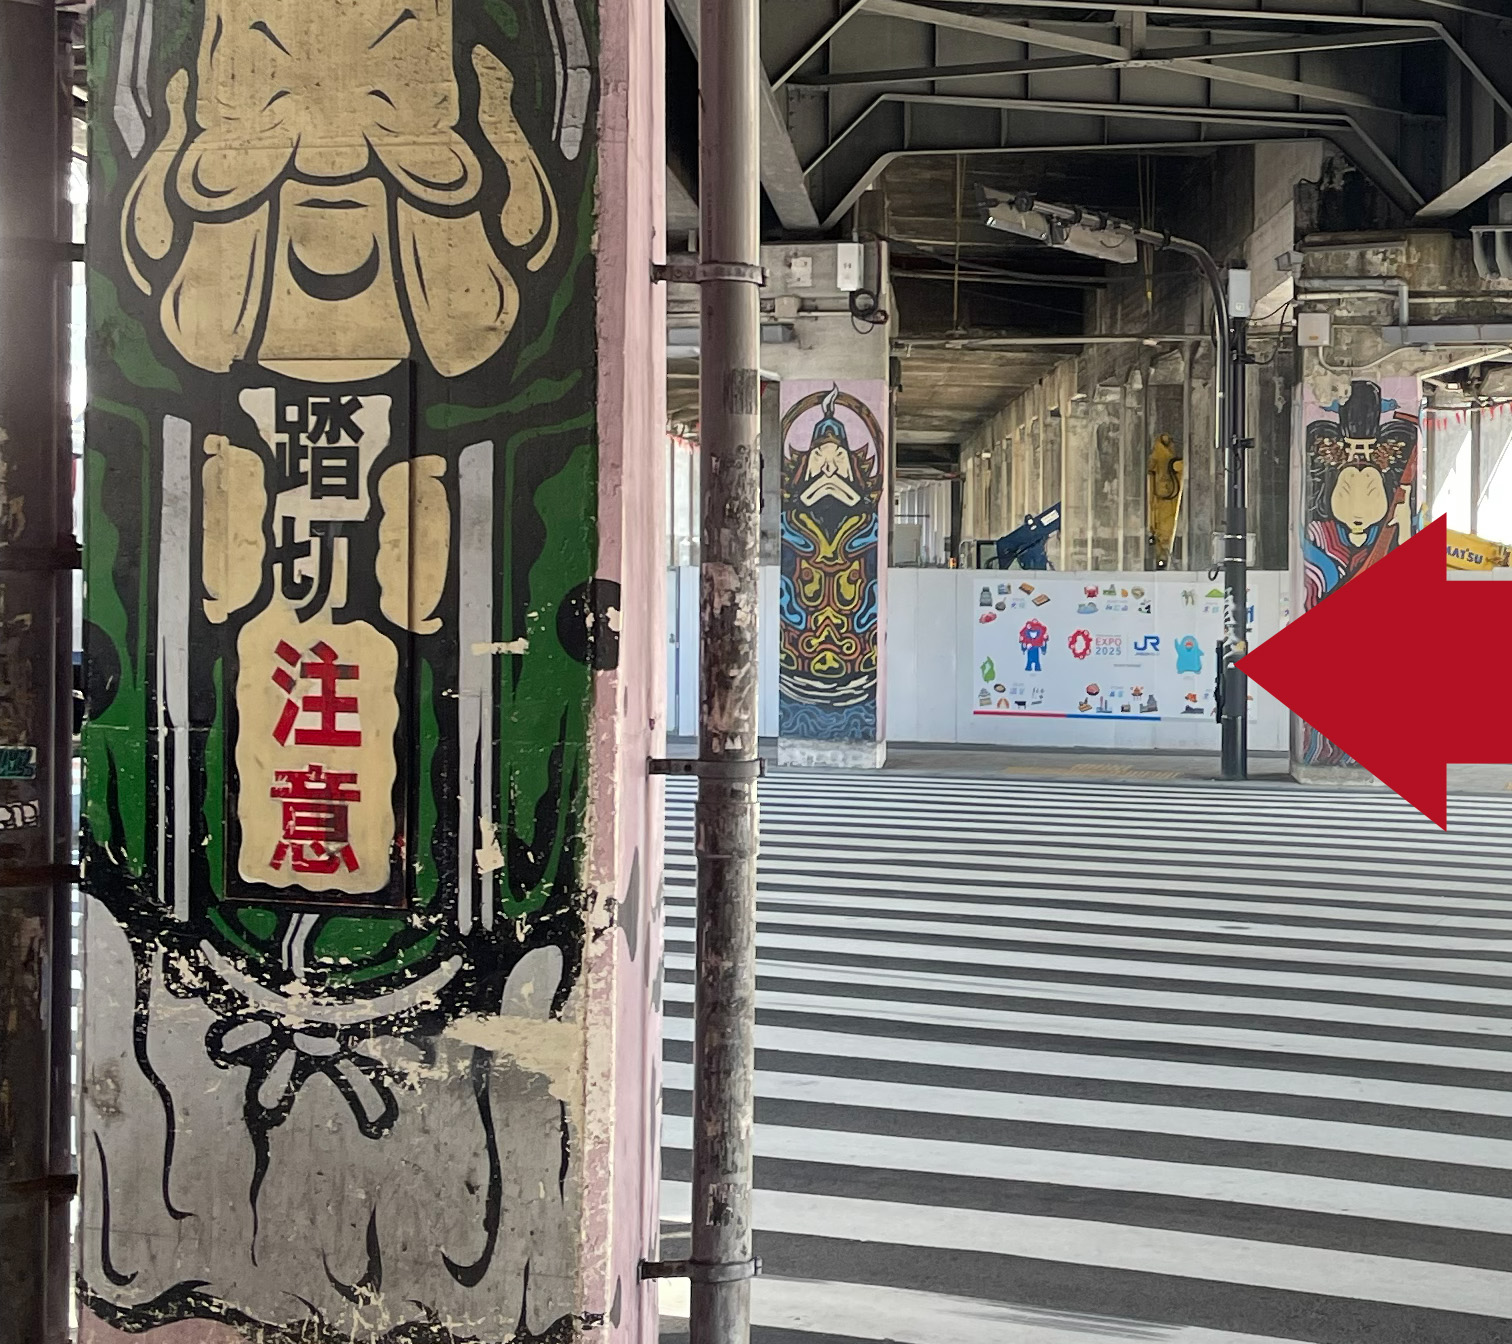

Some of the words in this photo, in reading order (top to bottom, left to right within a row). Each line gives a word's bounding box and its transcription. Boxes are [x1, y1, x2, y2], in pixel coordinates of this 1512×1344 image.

[270, 394, 364, 875] 踏切注意
[1096, 637, 1122, 646] EXPO
[1134, 635, 1160, 652] JR
[1096, 647, 1122, 656] 2025
